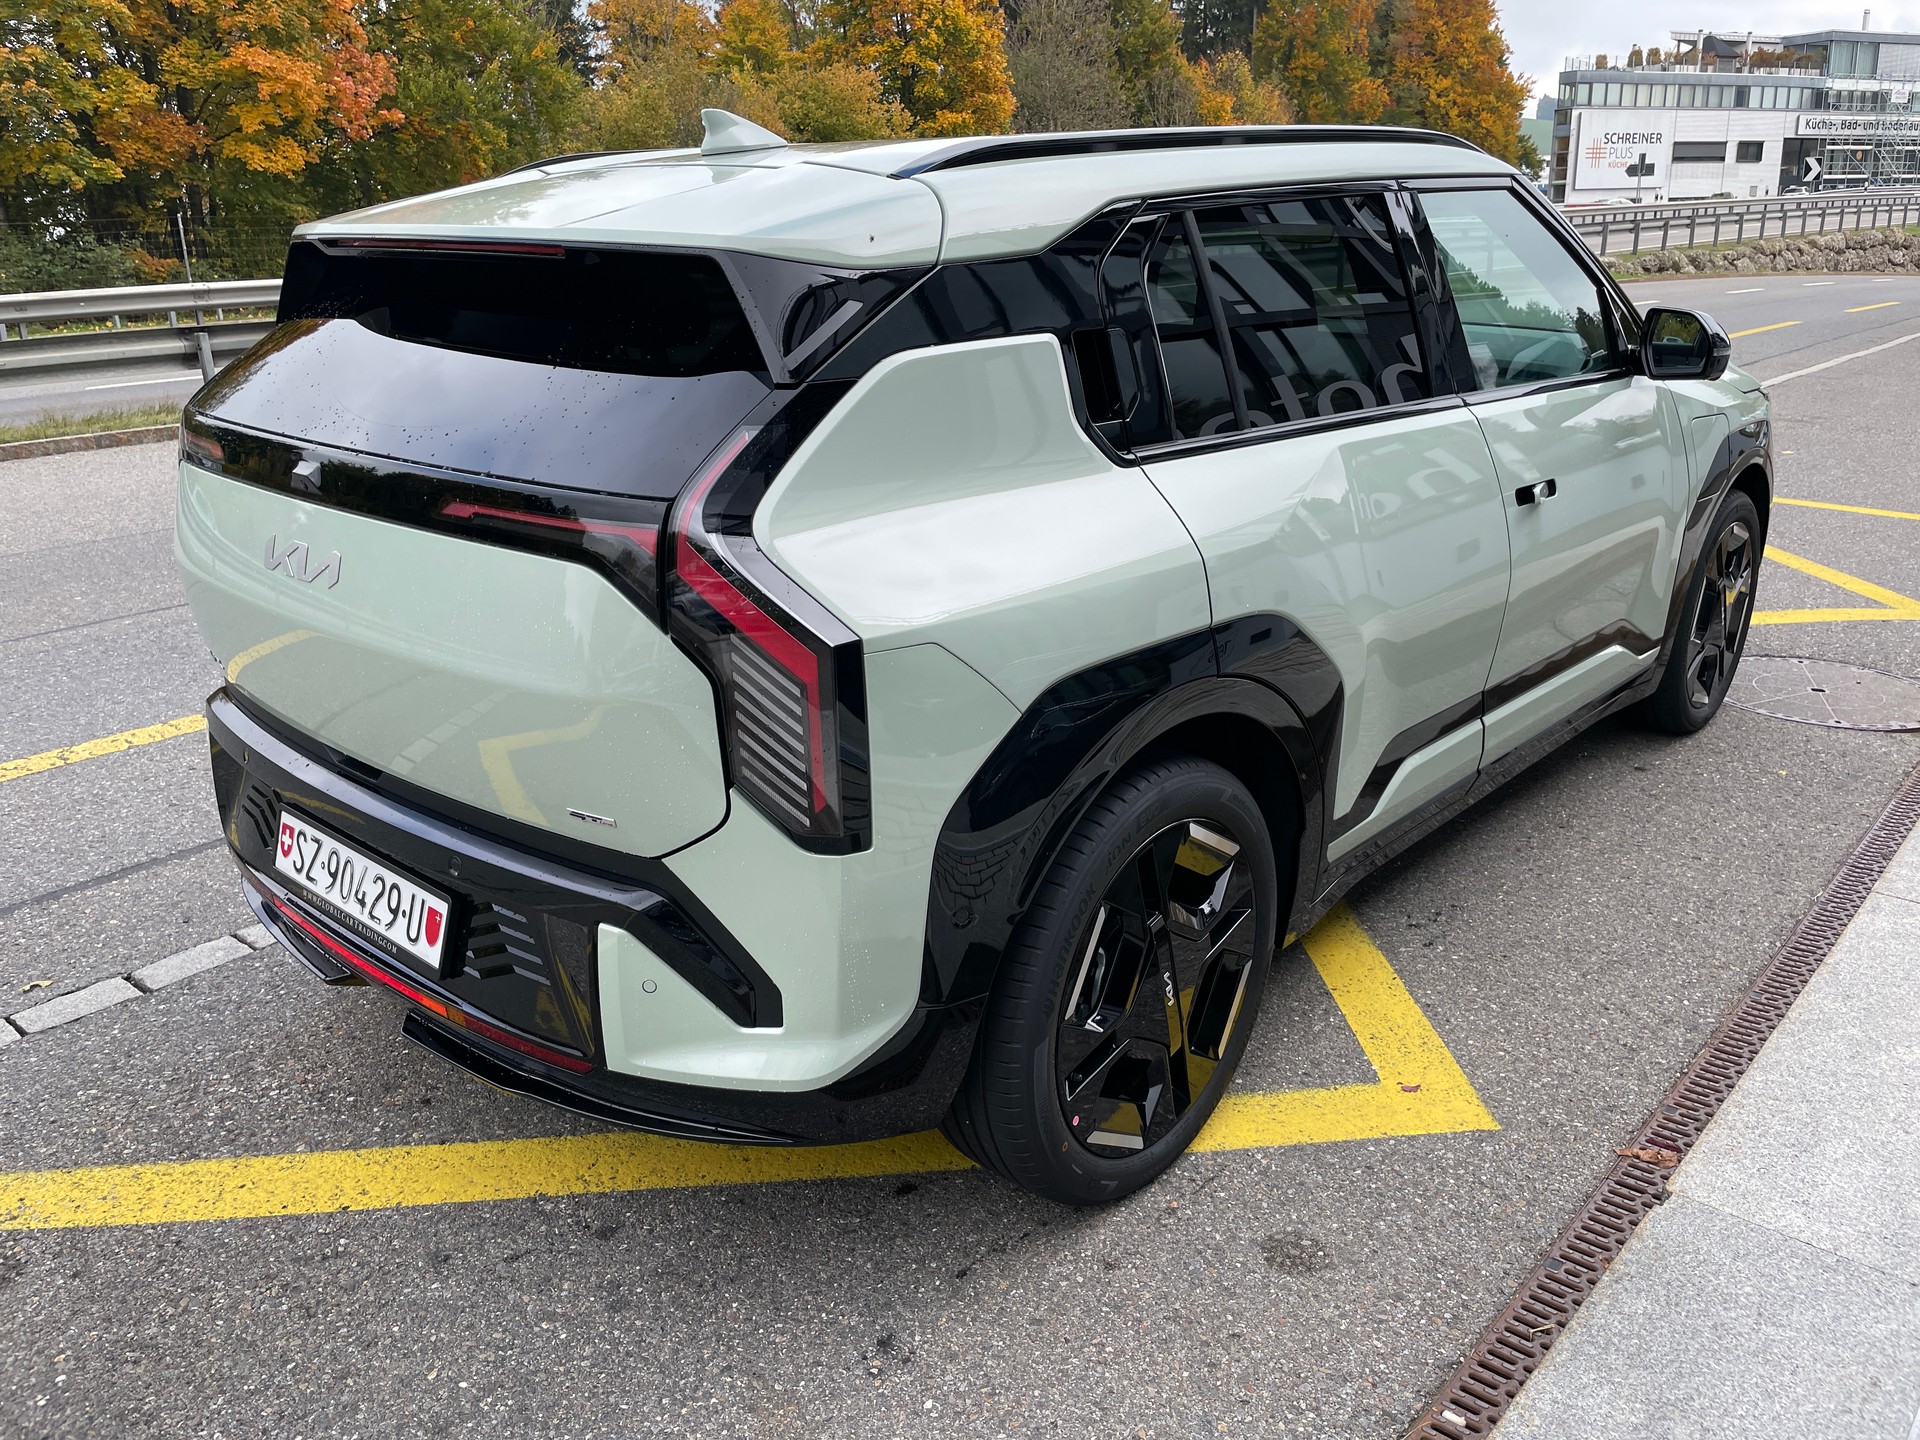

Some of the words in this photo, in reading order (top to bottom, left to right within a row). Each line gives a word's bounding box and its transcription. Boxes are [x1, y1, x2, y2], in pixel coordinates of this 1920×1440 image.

[1840, 119, 1861, 130] Bad-
[1603, 132, 1663, 145] SCHREINER
[1608, 147, 1634, 159] PLUS
[264, 533, 343, 590] KIA
